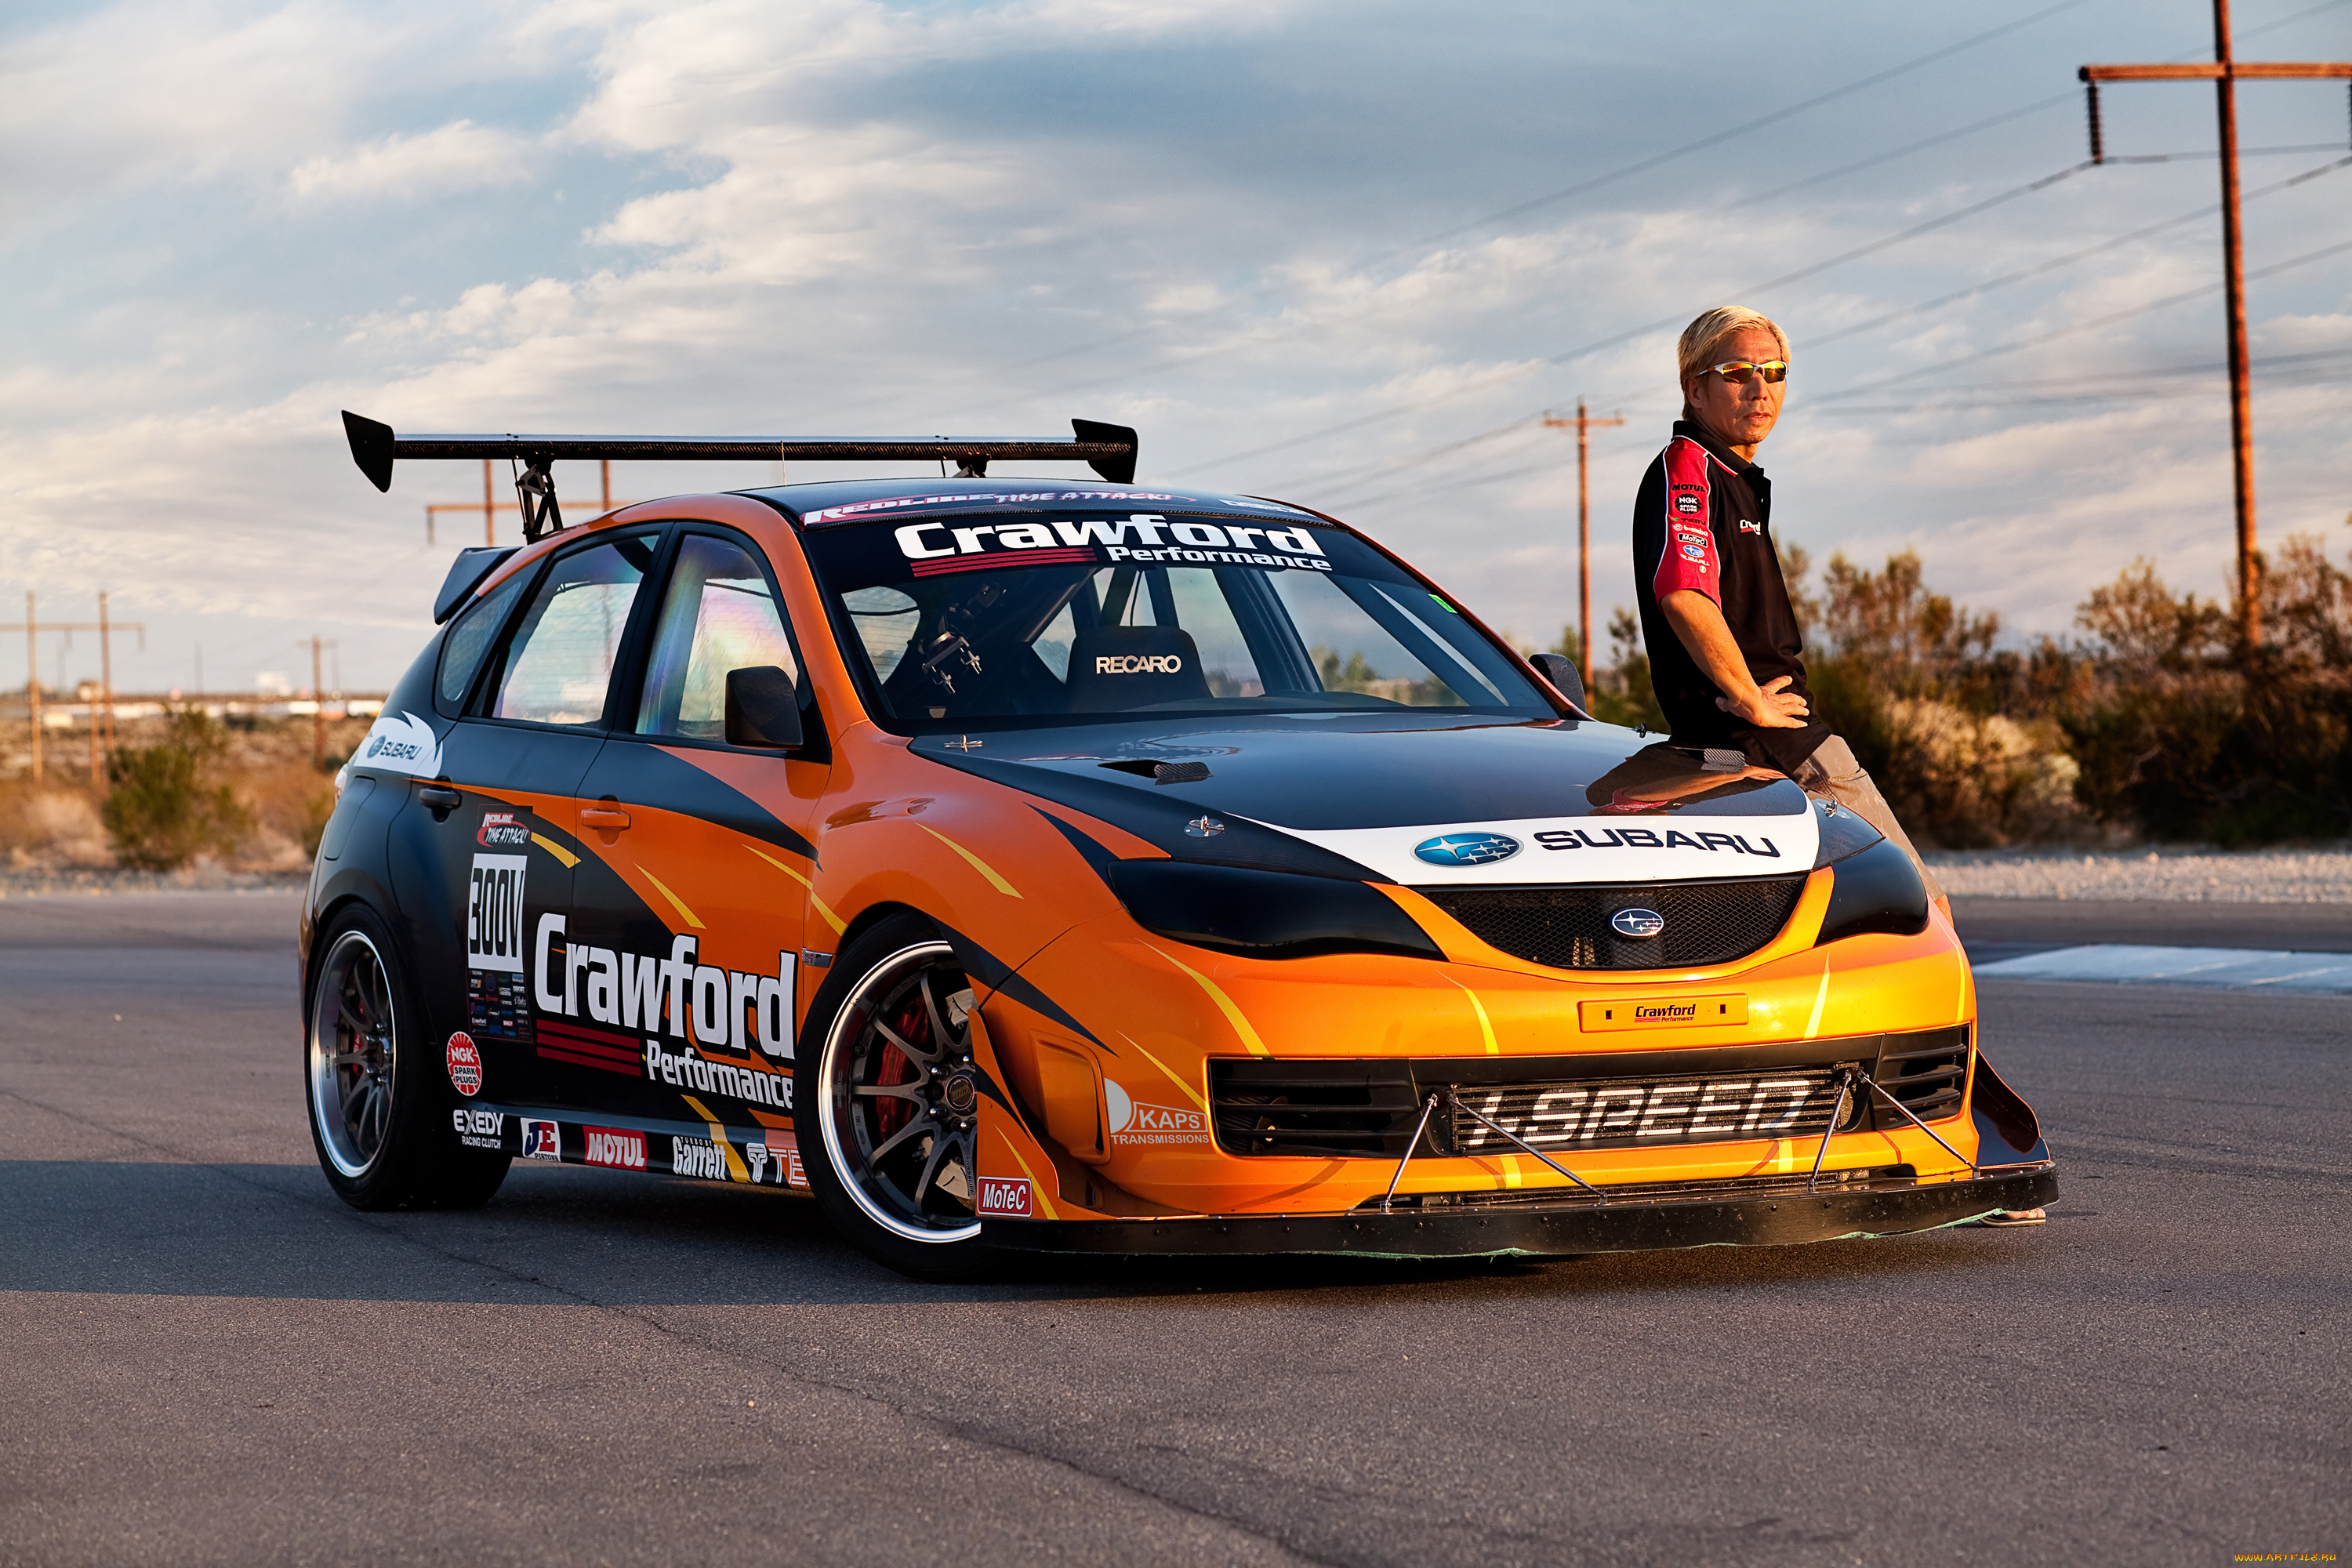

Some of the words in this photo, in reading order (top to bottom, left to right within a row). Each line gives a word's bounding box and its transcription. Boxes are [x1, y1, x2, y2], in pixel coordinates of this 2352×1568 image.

[1671, 484, 1705, 492] MOTUL
[994, 493, 1055, 503] TIME
[895, 514, 1327, 559] Crawford
[1683, 524, 1709, 536] brembo
[1105, 546, 1333, 571] Performance
[1096, 655, 1181, 674] RECARO
[380, 742, 422, 760] SUBARU
[485, 827, 503, 844] TIME
[1534, 829, 1781, 858] SUBARU
[470, 867, 524, 958] 300V
[535, 913, 795, 1060] Crawford
[1635, 1004, 1696, 1018] Crawford
[451, 1047, 474, 1063] NGK
[454, 1066, 476, 1076] SPARK
[456, 1076, 477, 1084] PLUGS
[647, 1039, 793, 1109] Performance
[453, 1109, 504, 1135] EXEDY
[1139, 1109, 1200, 1129] KAPS
[462, 1136, 481, 1147] RACING
[481, 1138, 502, 1149] CLUTCH
[524, 1121, 556, 1157] JE
[681, 1137, 703, 1146] TURBO
[1110, 1134, 1210, 1145] TRANSMISSIONS
[535, 1152, 559, 1162] PISTONS
[586, 1133, 646, 1167] MOTUL
[673, 1136, 727, 1181] Garrett
[768, 1148, 811, 1187] TE
[982, 1183, 1026, 1210] MoTeC
